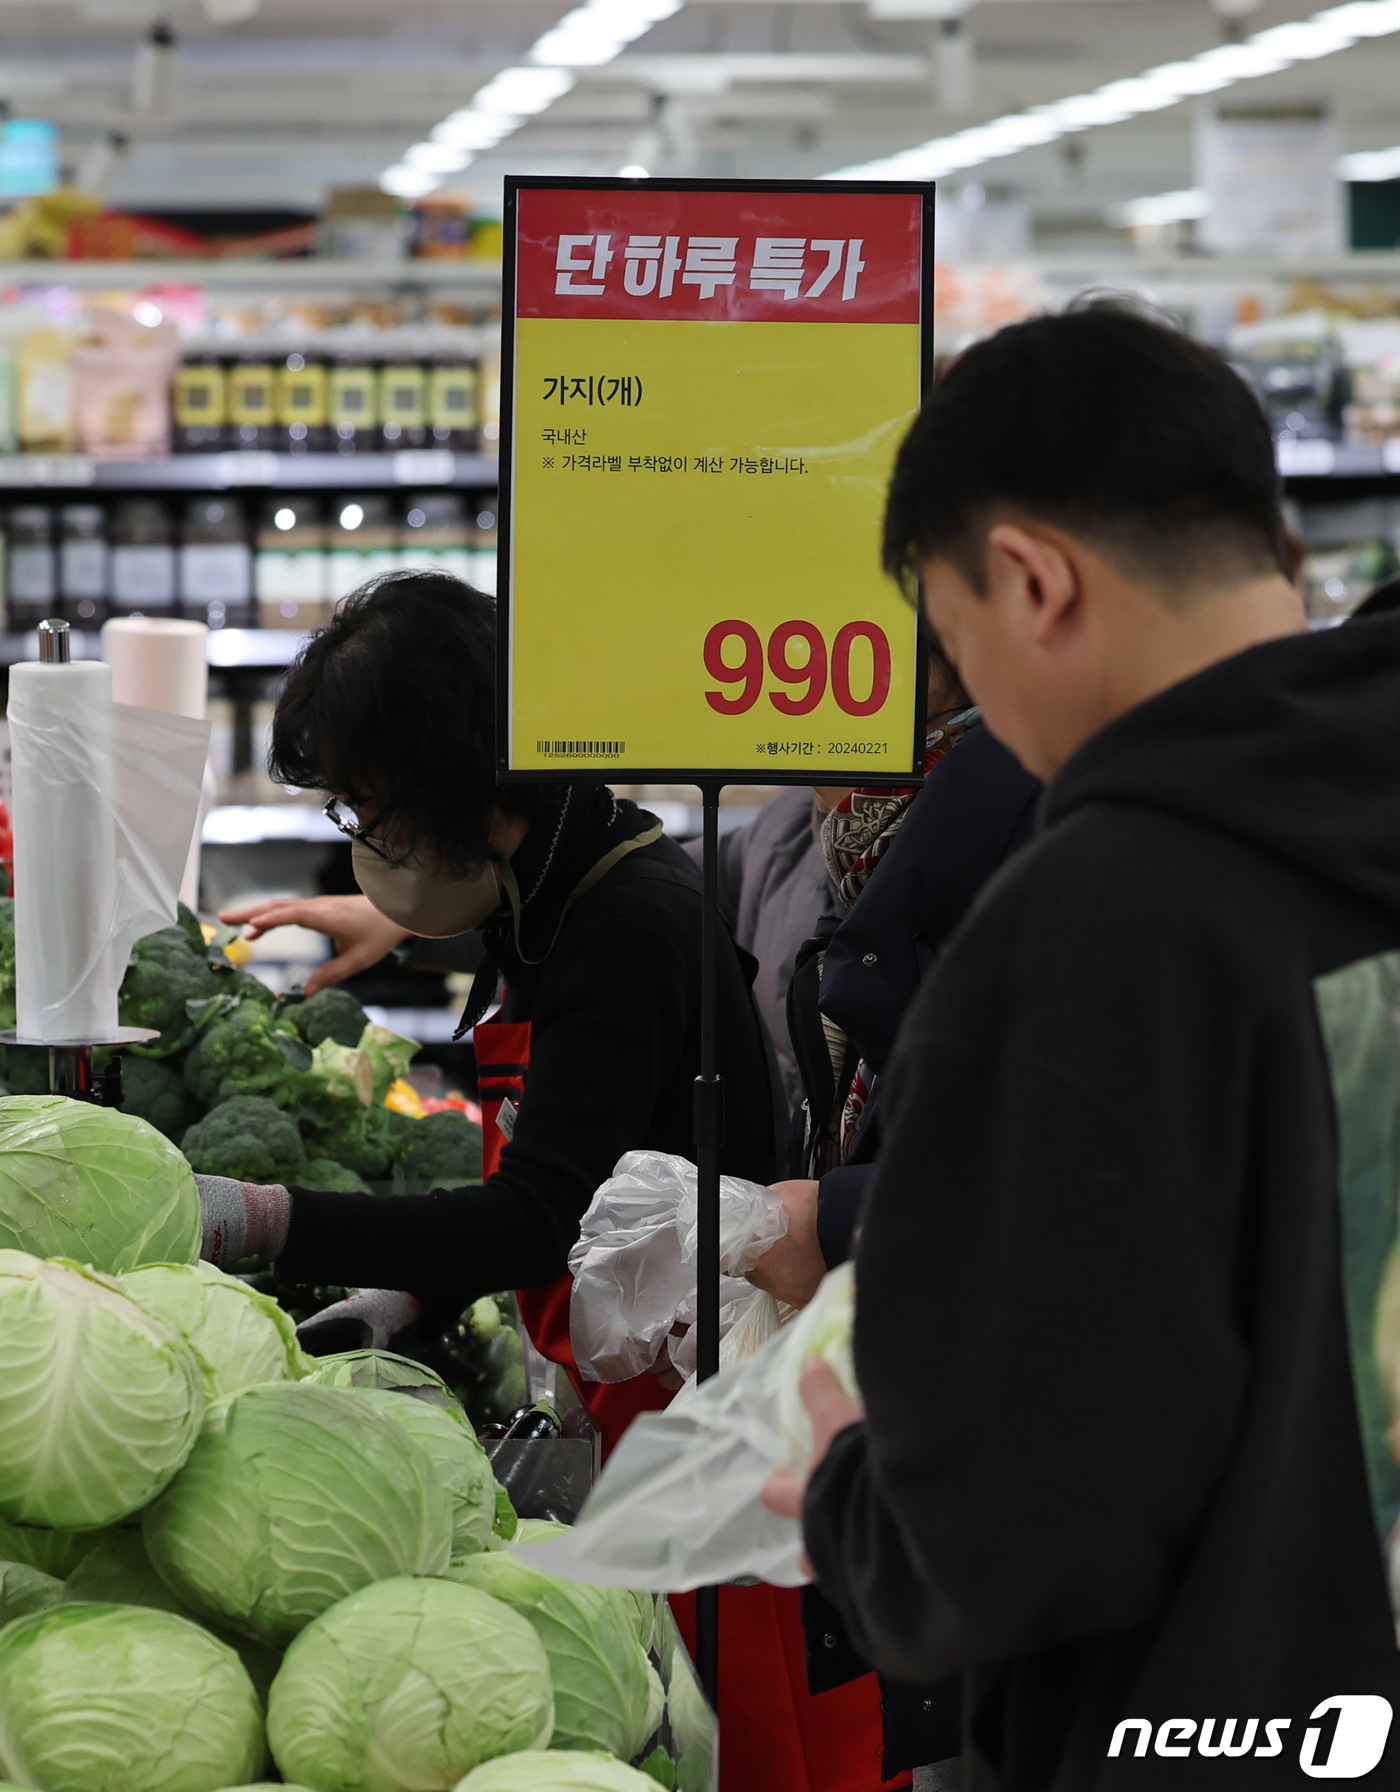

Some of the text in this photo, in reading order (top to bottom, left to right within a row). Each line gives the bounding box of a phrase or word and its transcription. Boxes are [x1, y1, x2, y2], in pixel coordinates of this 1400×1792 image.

[555, 234, 866, 302] 단 하루 특가
[542, 375, 643, 407] 가지(개)
[540, 428, 588, 446] 국내산
[561, 455, 622, 472] 가격라벨
[627, 456, 688, 473] 부착없이
[693, 457, 724, 474] 계산
[729, 457, 809, 475] 가능합니다.
[703, 619, 892, 717] 990
[827, 742, 888, 754] 20240221
